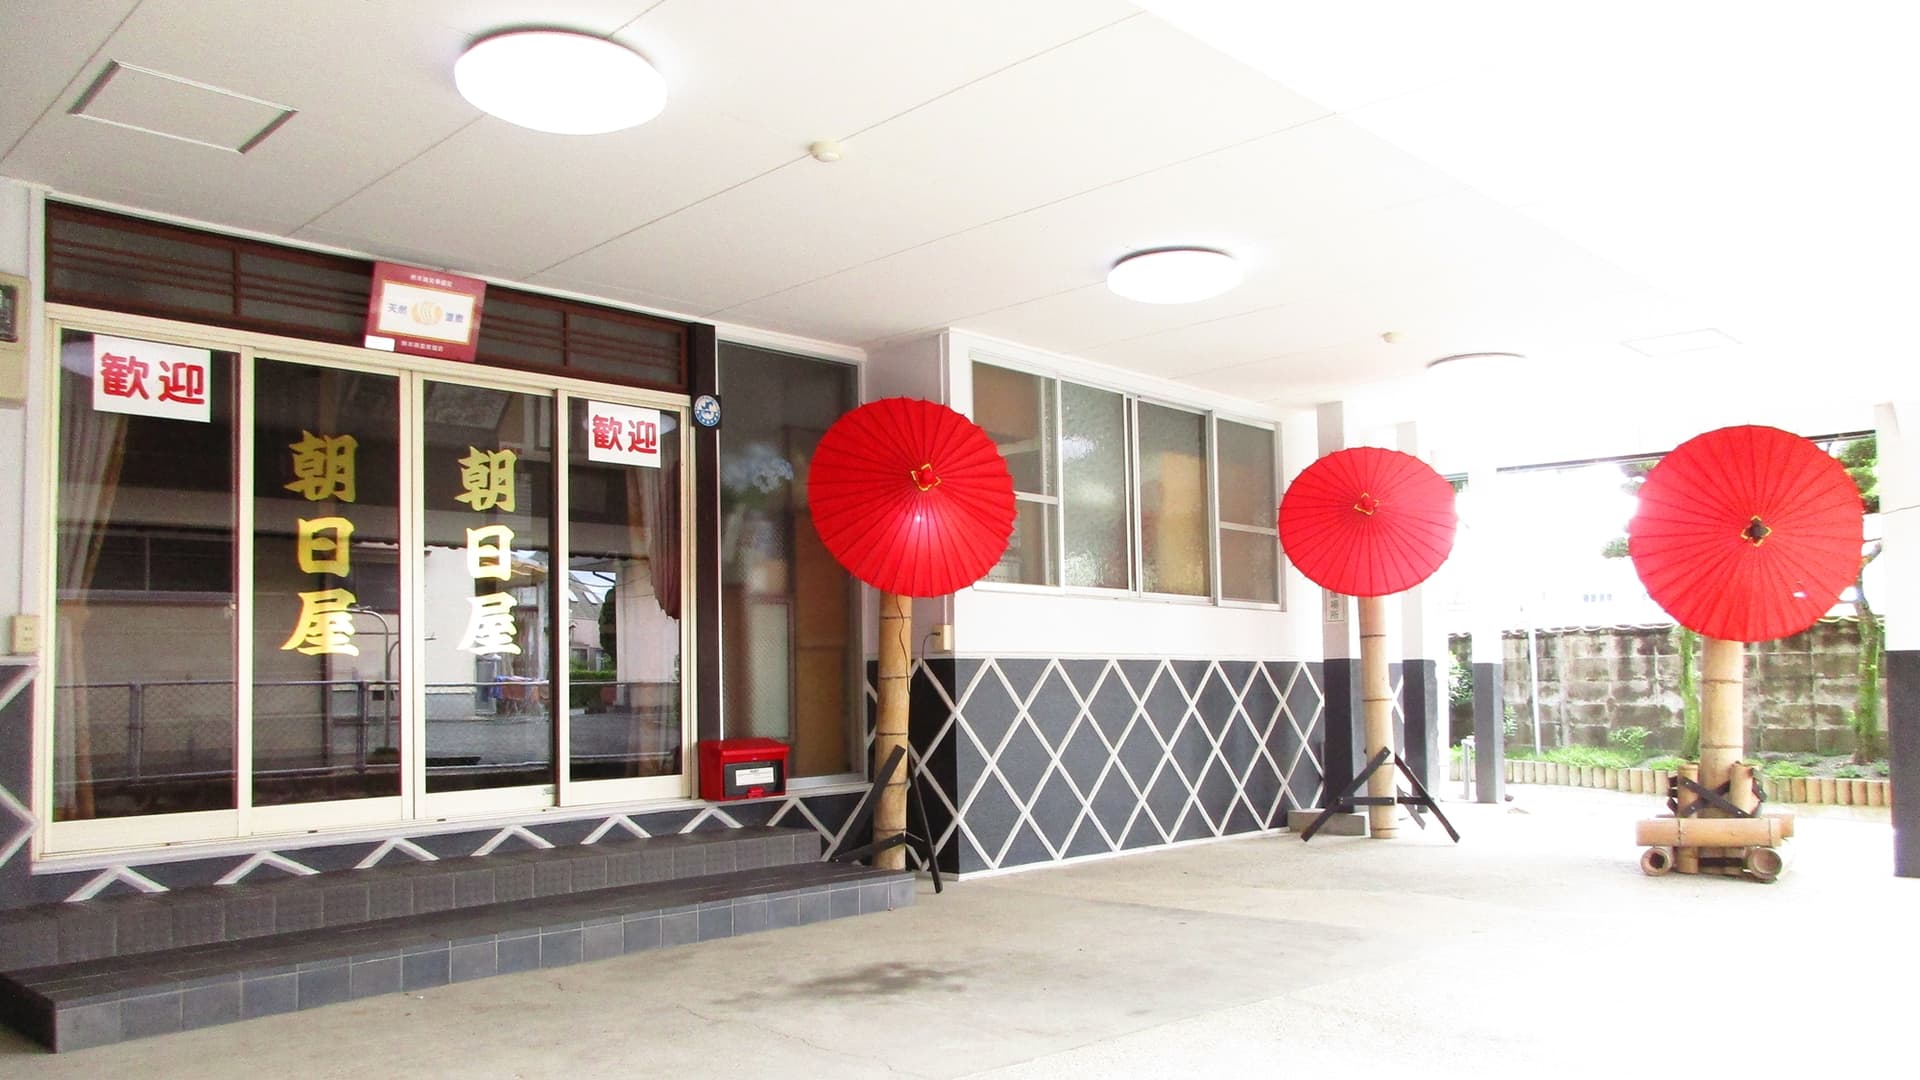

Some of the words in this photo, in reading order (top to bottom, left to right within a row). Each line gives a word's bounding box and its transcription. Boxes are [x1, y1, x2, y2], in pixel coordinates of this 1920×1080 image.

[100, 352, 205, 405] 歓迎
[592, 414, 657, 454] 歓迎
[280, 430, 360, 657] 朝日屋
[454, 446, 522, 657] 朝日屋
